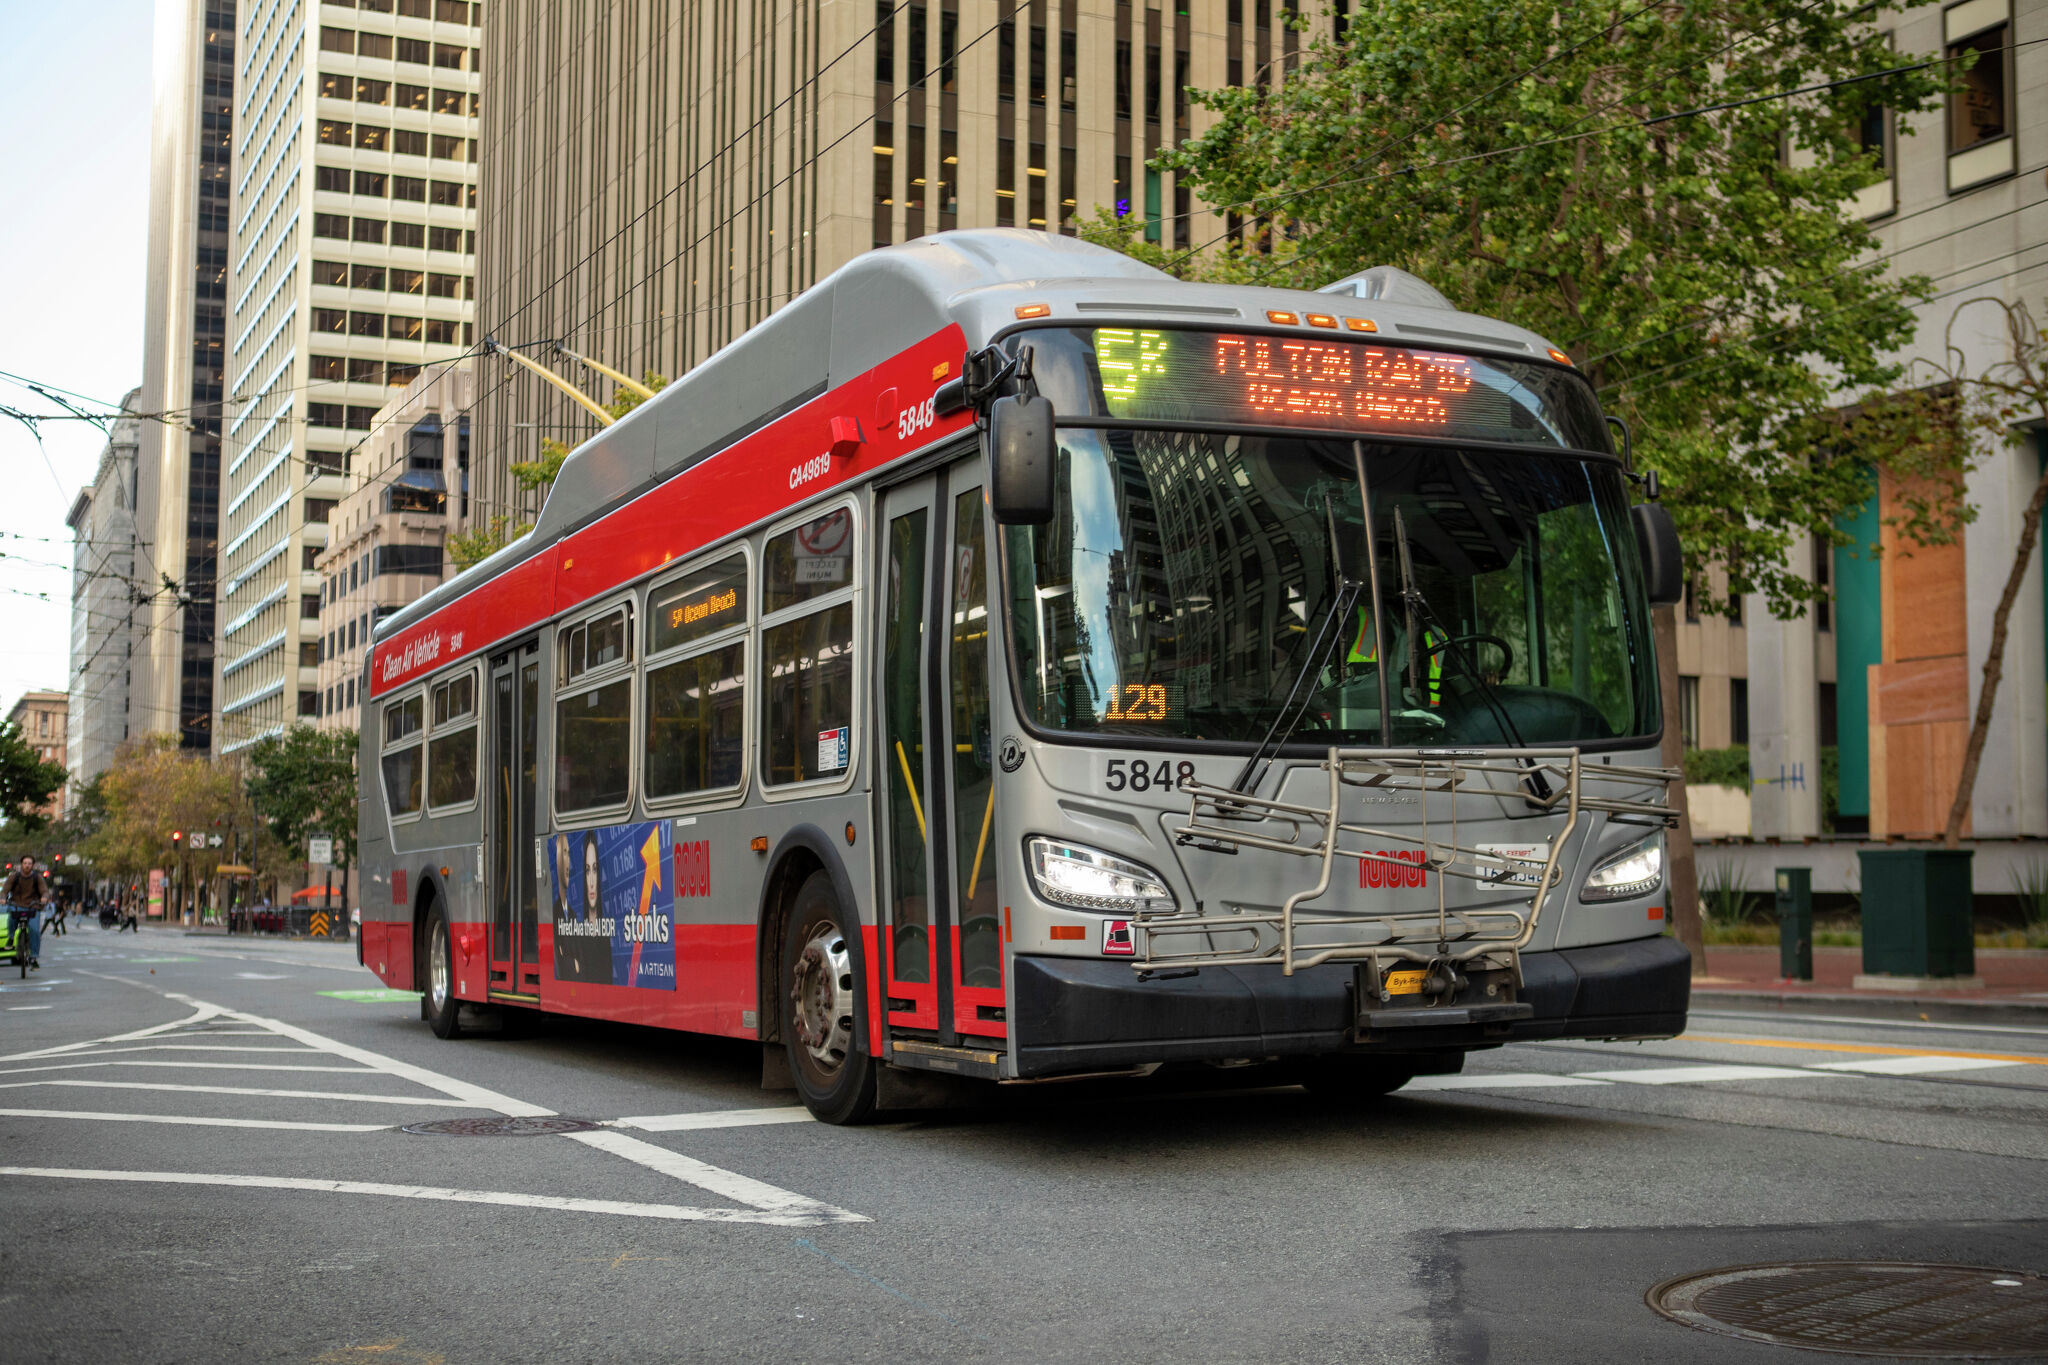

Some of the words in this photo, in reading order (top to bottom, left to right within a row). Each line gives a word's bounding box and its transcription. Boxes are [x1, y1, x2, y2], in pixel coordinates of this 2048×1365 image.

[1098, 328, 1167, 400] 5R
[1217, 339, 1351, 382] FULTON
[1365, 352, 1471, 393] RAPID
[898, 397, 934, 440] 5848
[789, 451, 830, 490] CA49819
[685, 602, 708, 624] Ocean
[711, 588, 736, 614] Beach
[383, 653, 402, 683] Clean
[401, 642, 413, 674] Air
[414, 629, 440, 668] Vehicle
[1106, 684, 1166, 719] 129
[1105, 759, 1195, 792] 5848
[558, 918, 572, 936] Hired
[573, 918, 584, 936] Ava
[584, 918, 594, 936] the
[594, 918, 600, 936] AI
[602, 918, 615, 936] BDR
[624, 904, 669, 943] stonks
[645, 962, 674, 977] ARTISAN
